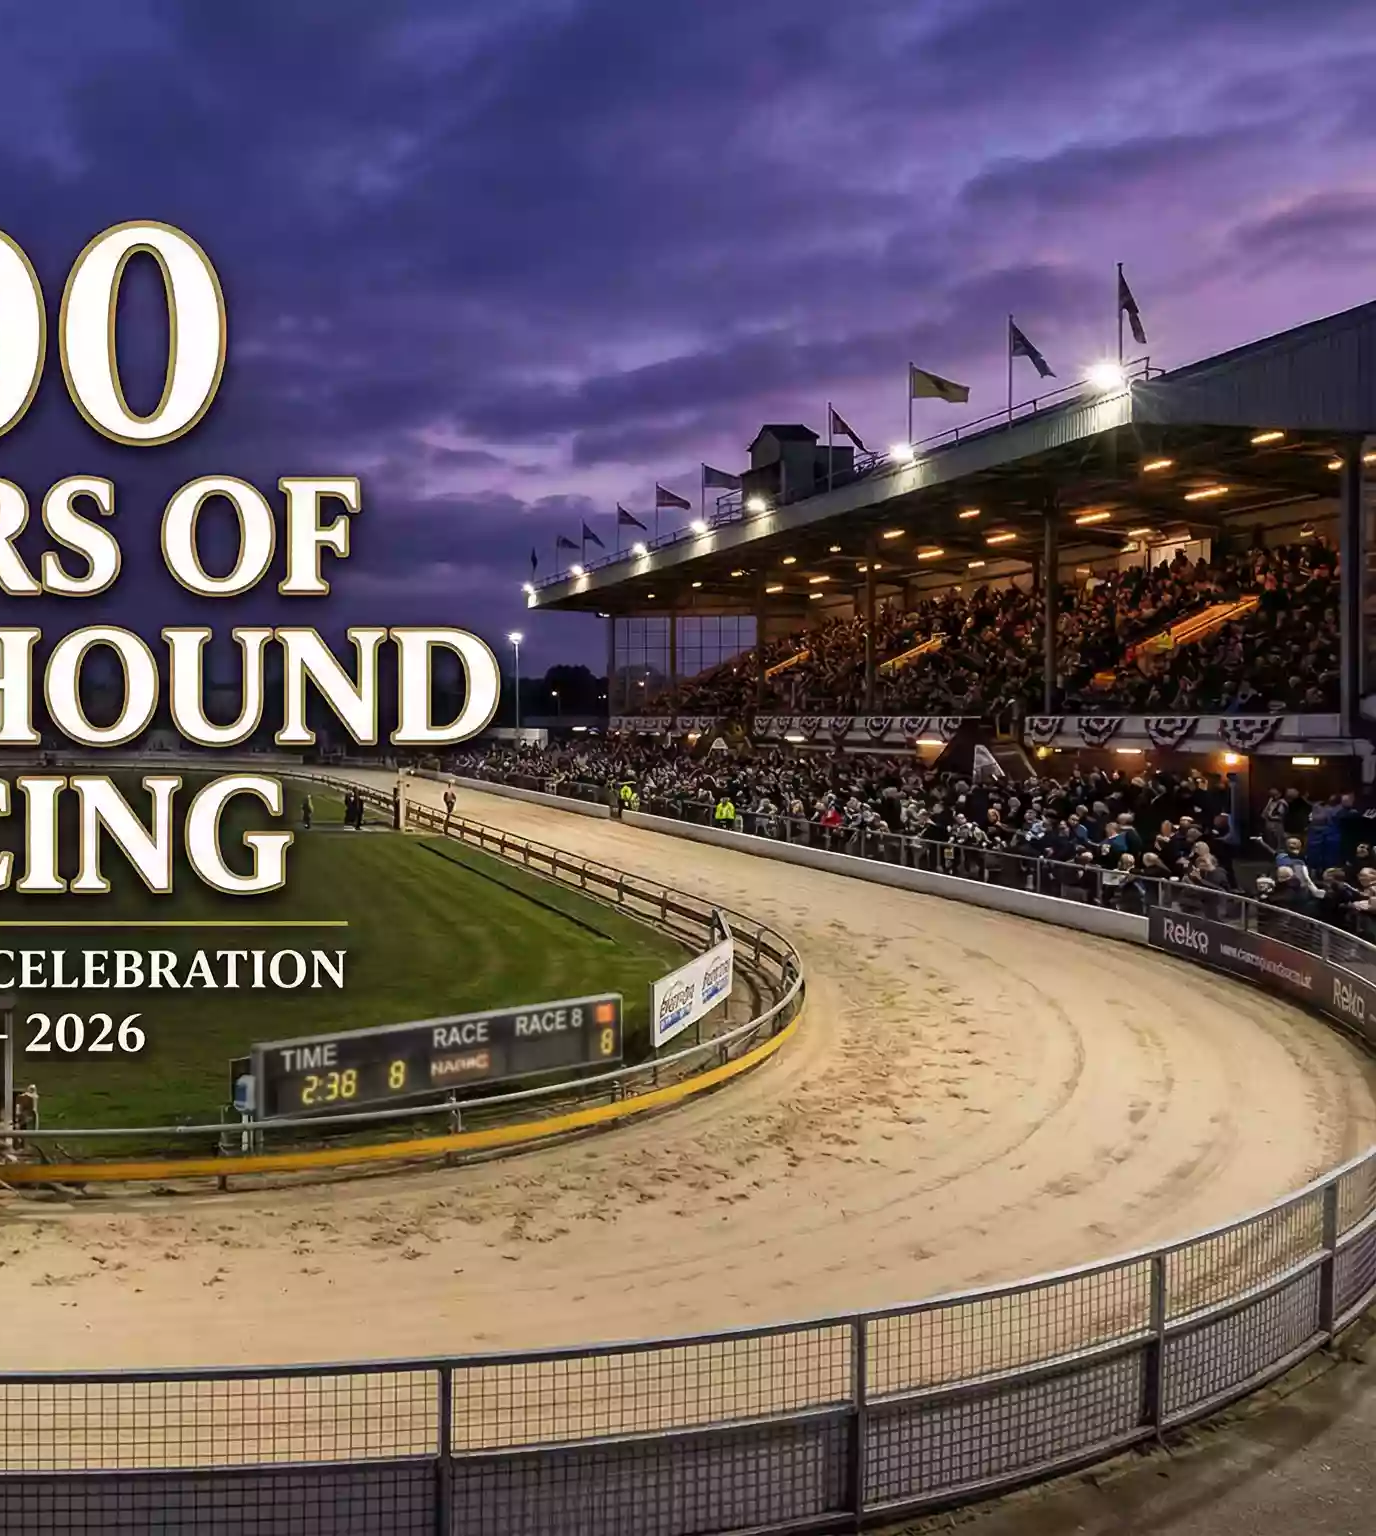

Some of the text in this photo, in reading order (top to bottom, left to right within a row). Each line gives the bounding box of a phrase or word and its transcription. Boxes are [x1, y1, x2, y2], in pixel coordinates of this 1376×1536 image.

[432, 1021, 490, 1049] RACE
[515, 1007, 583, 1037] RACE 8
[600, 1027, 614, 1055] 8
[280, 1043, 338, 1073] TIME
[302, 1068, 358, 1105] 2:38
[388, 1059, 406, 1090] 8
